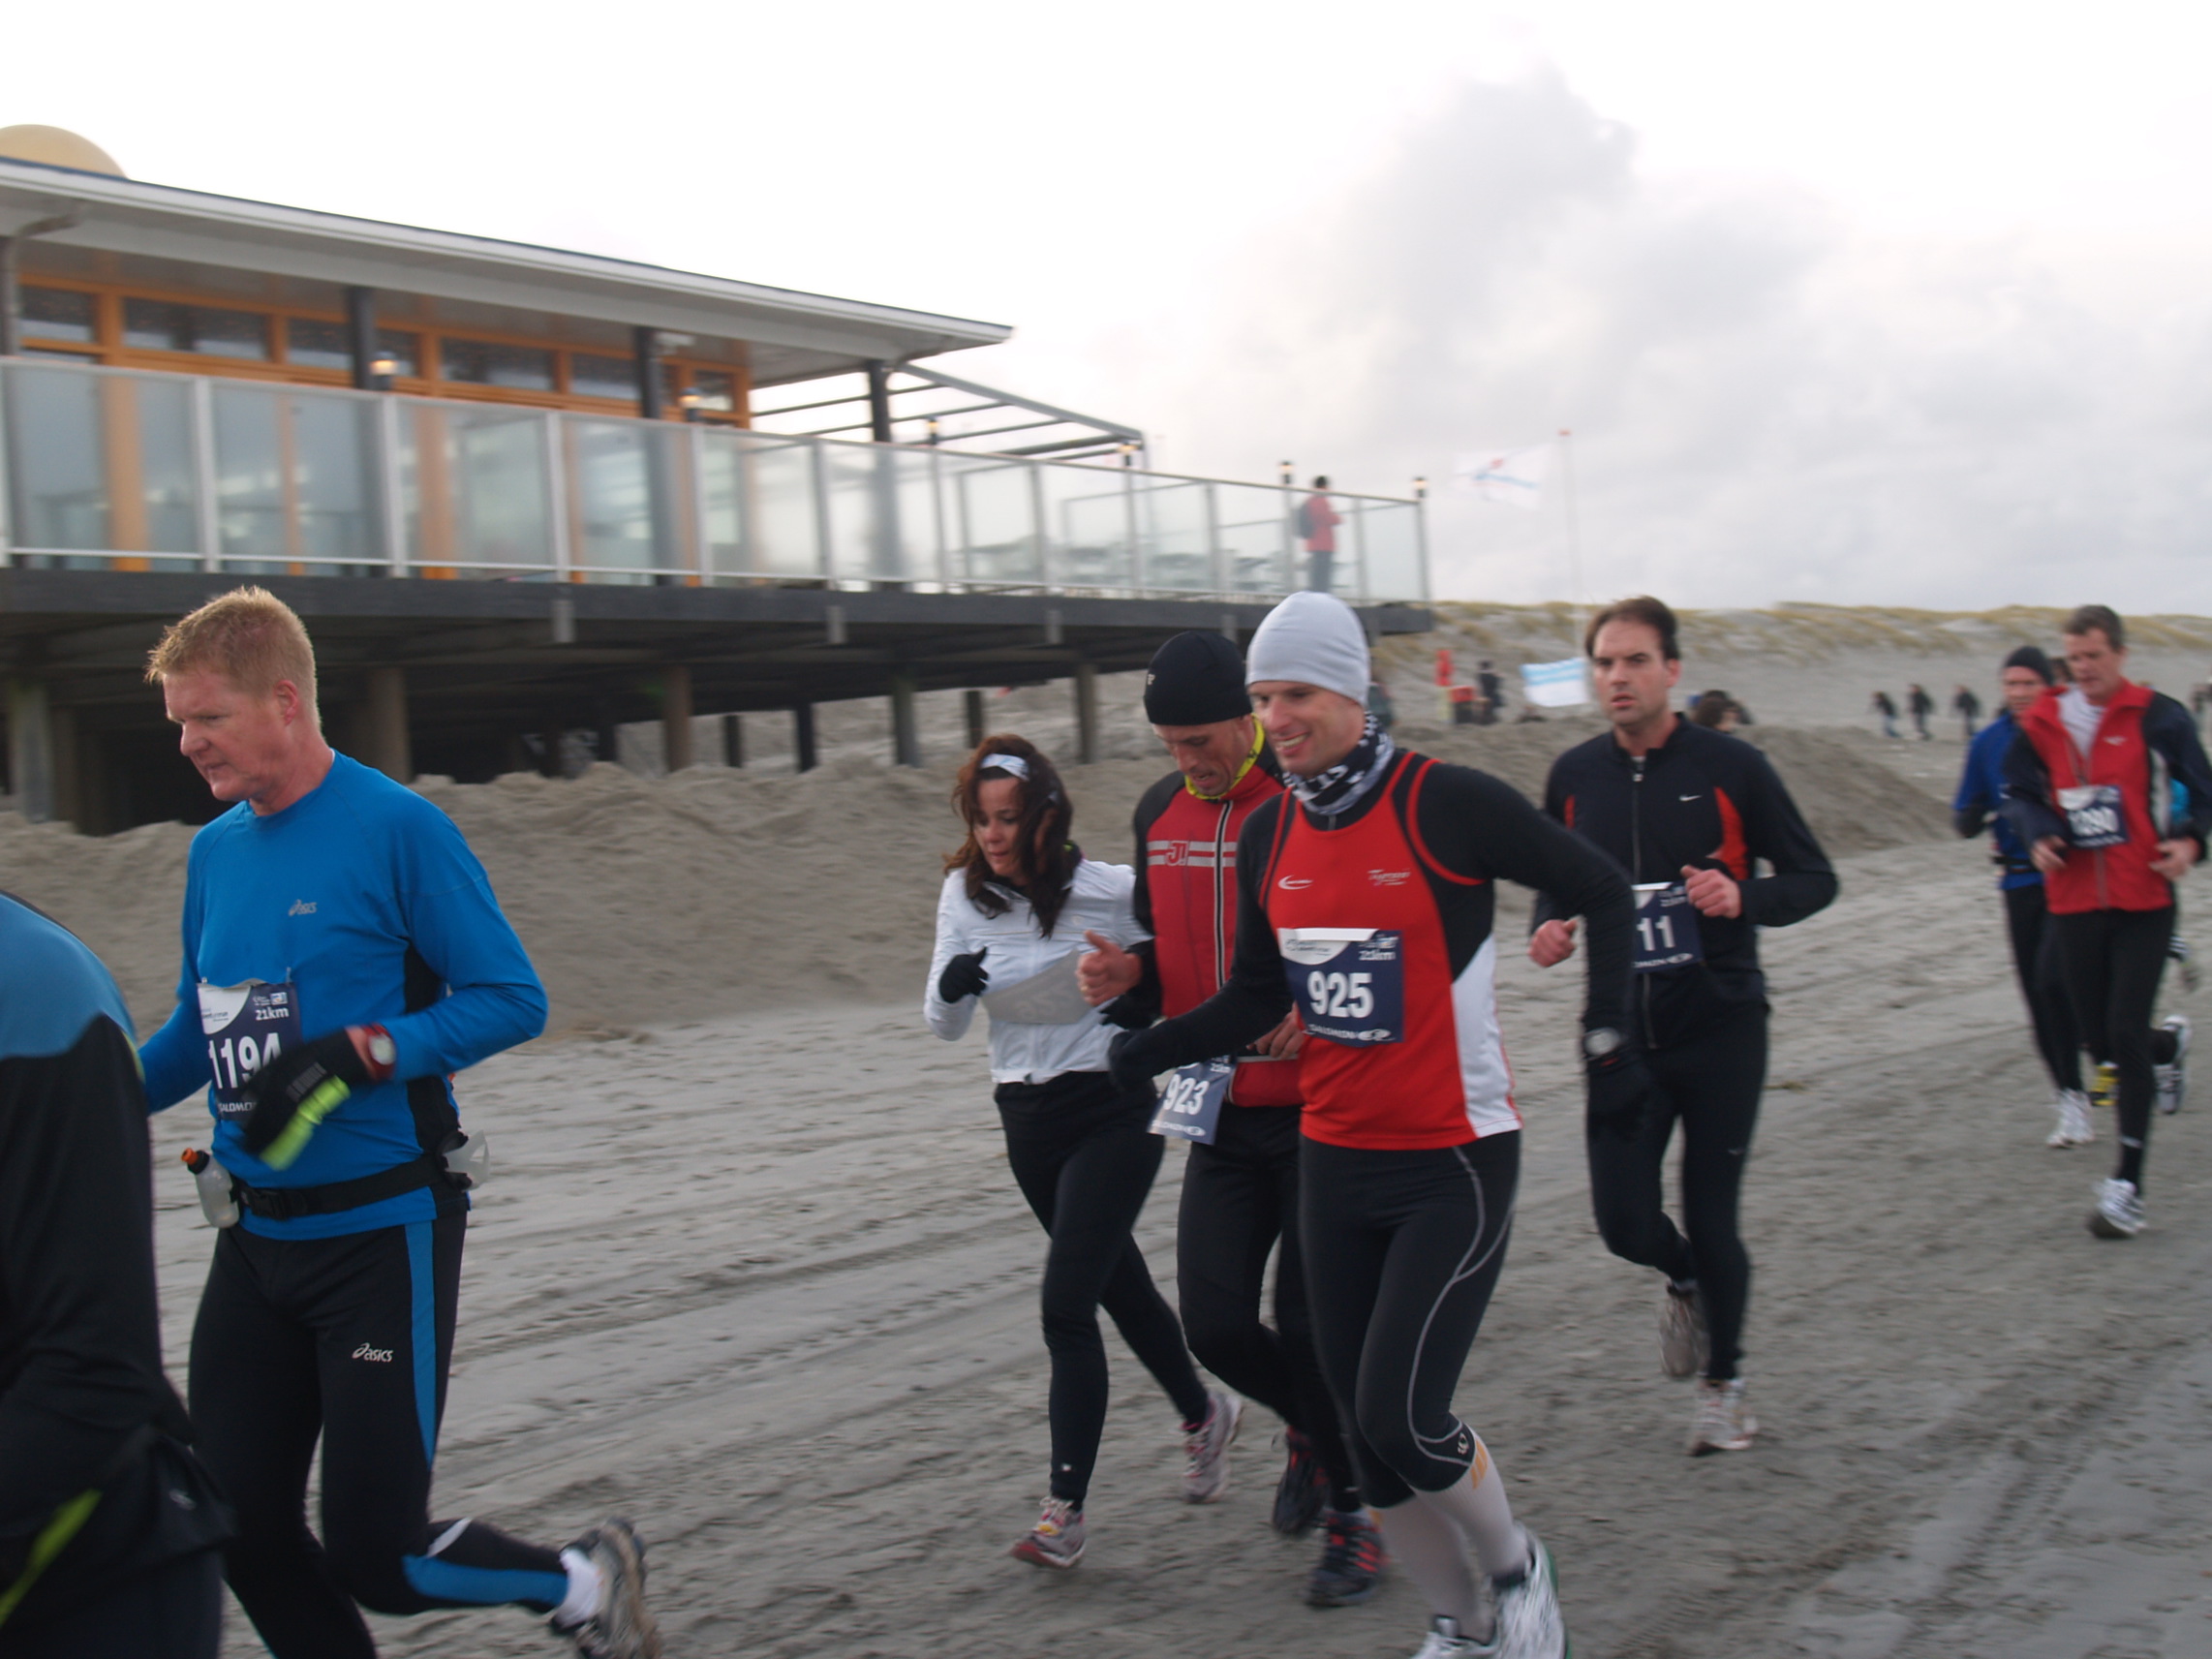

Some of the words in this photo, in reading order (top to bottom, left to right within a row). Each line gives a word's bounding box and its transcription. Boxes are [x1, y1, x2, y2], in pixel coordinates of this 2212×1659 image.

[1636, 916, 1675, 951] 11
[1306, 970, 1374, 1018] 925
[255, 1007, 290, 1021] 21km
[1162, 1073, 1210, 1116] 923
[353, 1343, 394, 1363] asics
